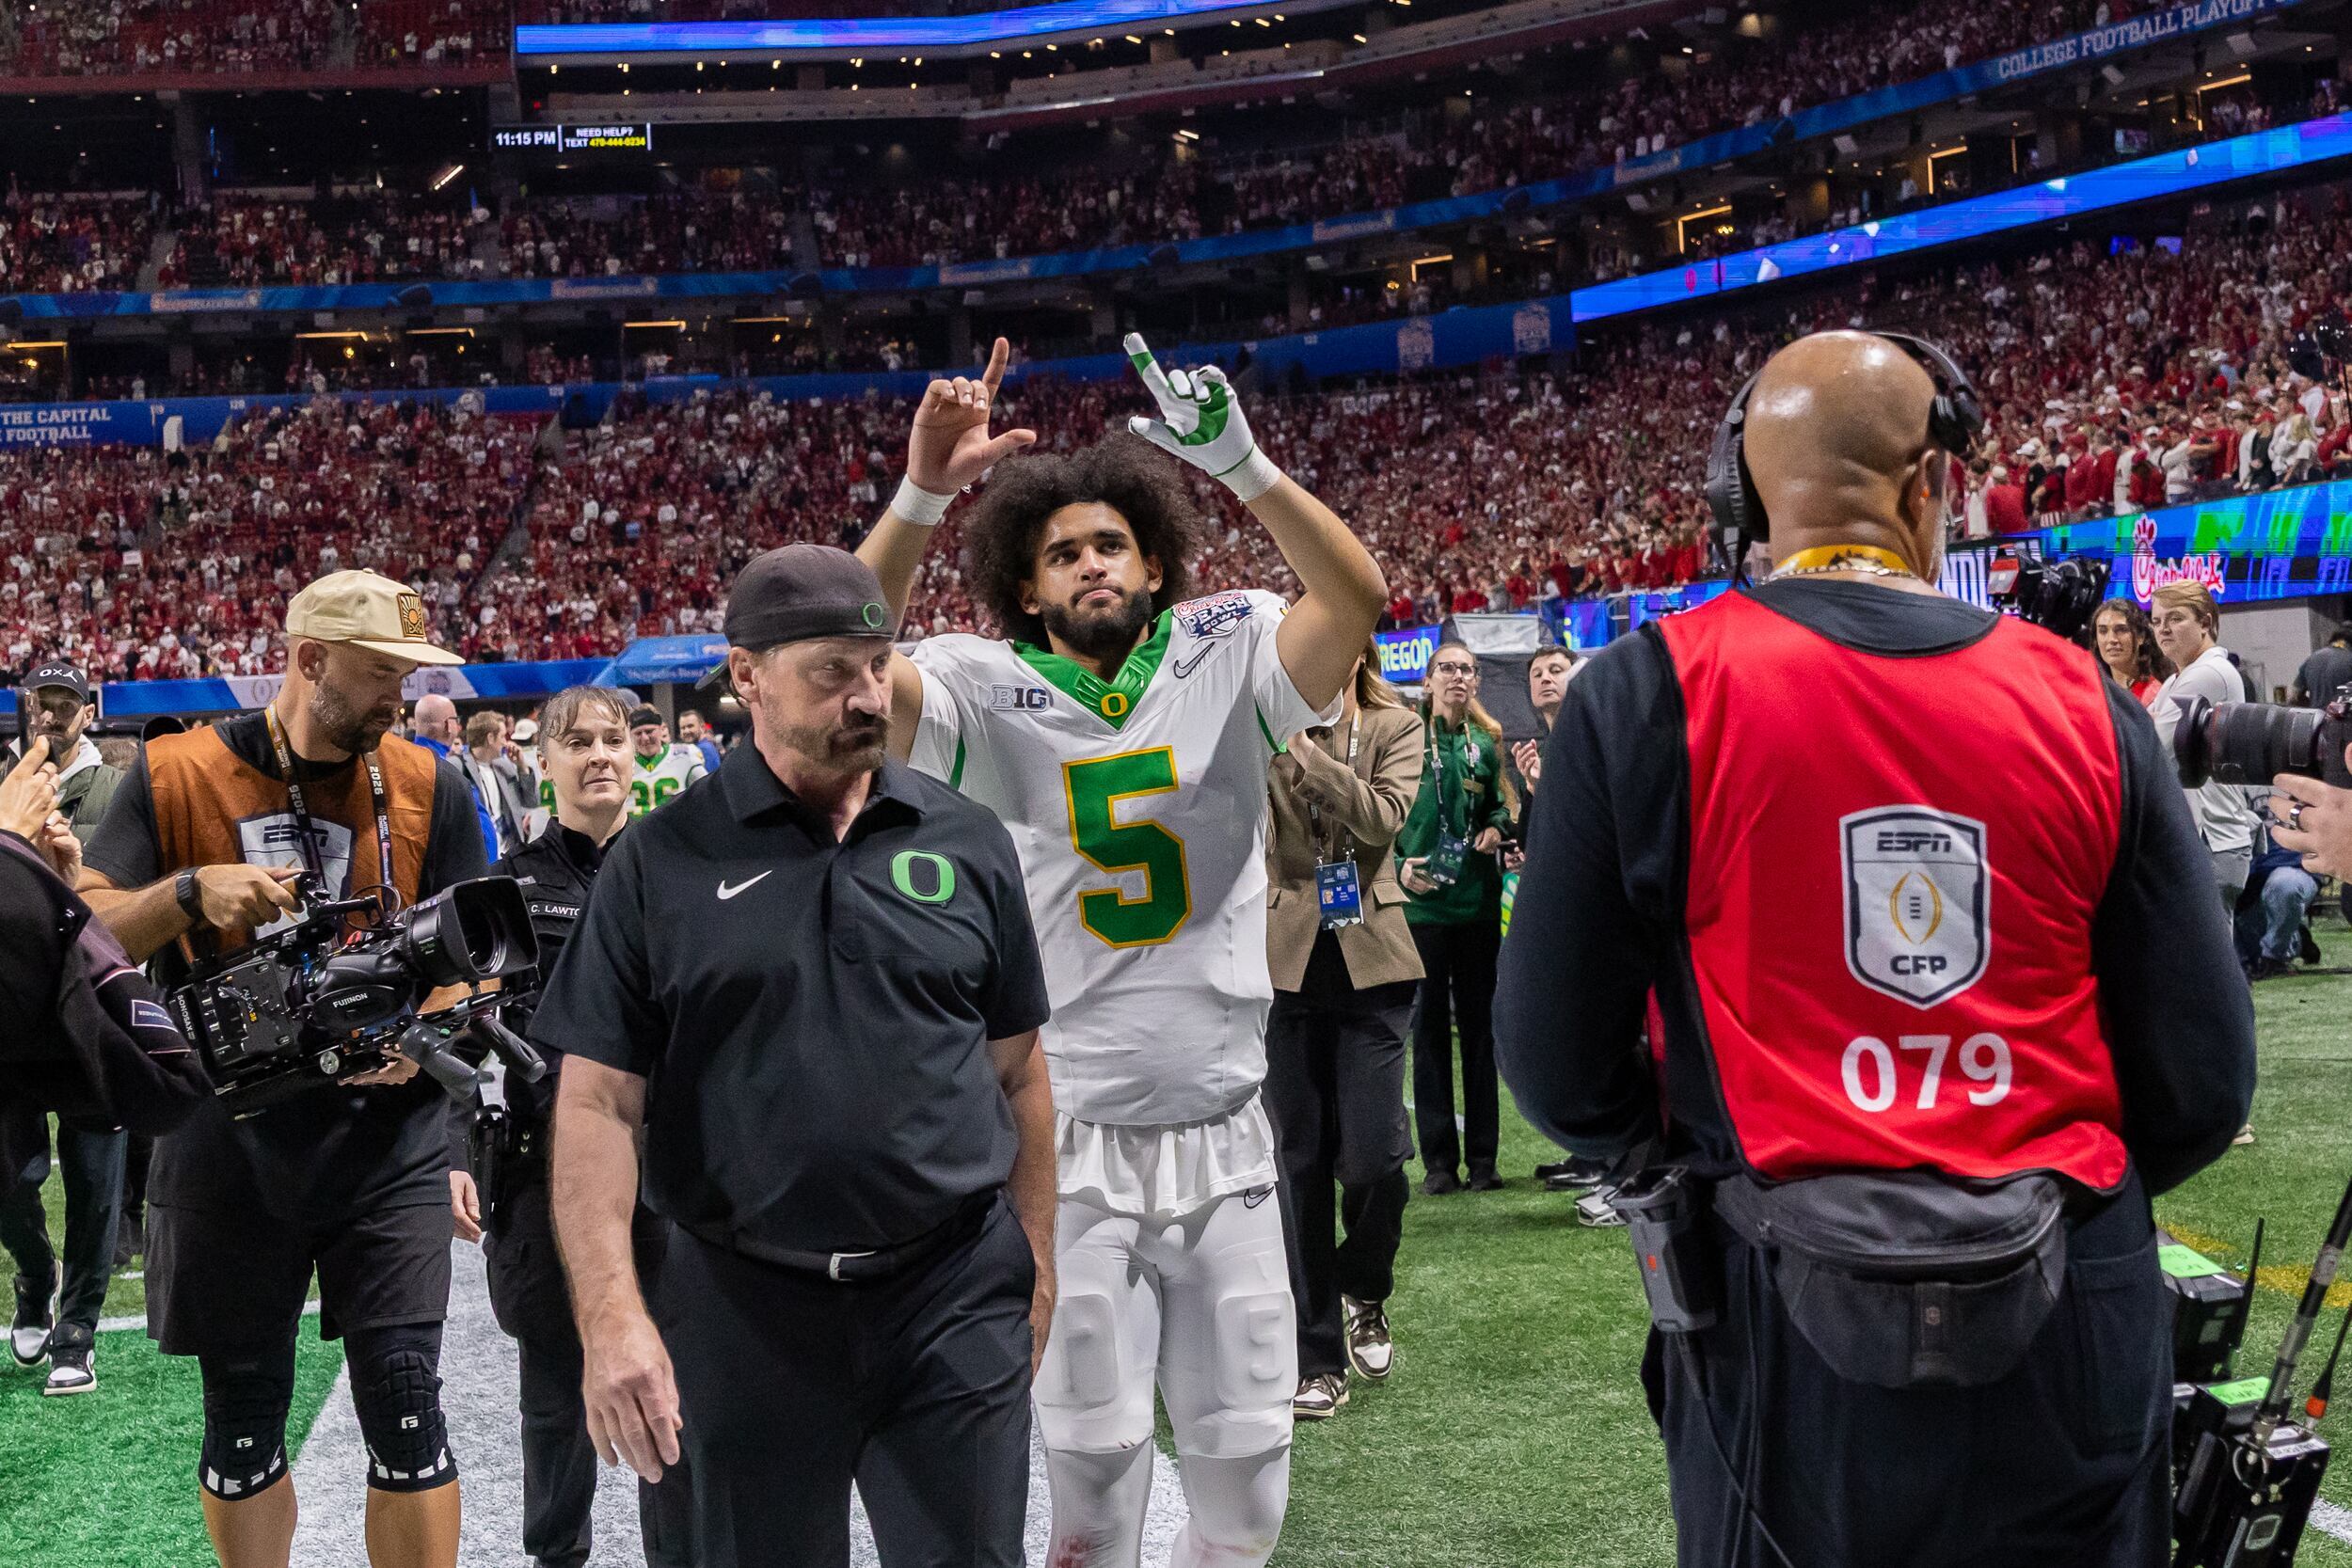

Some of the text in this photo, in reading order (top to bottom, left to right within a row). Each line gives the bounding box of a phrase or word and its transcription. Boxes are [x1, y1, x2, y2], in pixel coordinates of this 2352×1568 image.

[1998, 41, 2076, 79] COLLEGE
[2081, 19, 2178, 57] FOOTBALL
[495, 132, 556, 146] 11:15 PM
[565, 138, 588, 148] TEXT
[576, 127, 634, 137] NEED HELP?
[2, 408, 112, 425] THE CAPITAL
[7, 425, 92, 442] FOOTBALL
[1184, 597, 1249, 634] PEACH
[1203, 610, 1241, 631] BOWL
[1378, 639, 1433, 672] REGON
[1101, 693, 1128, 717] O
[369, 765, 384, 796] 2026
[288, 784, 307, 816] 2026
[1060, 745, 1193, 950] 5
[1877, 832, 1951, 853] ESPN
[890, 849, 956, 904] O
[531, 905, 540, 913] C.
[1889, 956, 1947, 974] CFP
[333, 992, 368, 1008] FUJINON
[177, 994, 193, 1032] SONOSAX
[1841, 1033, 2012, 1113] 079
